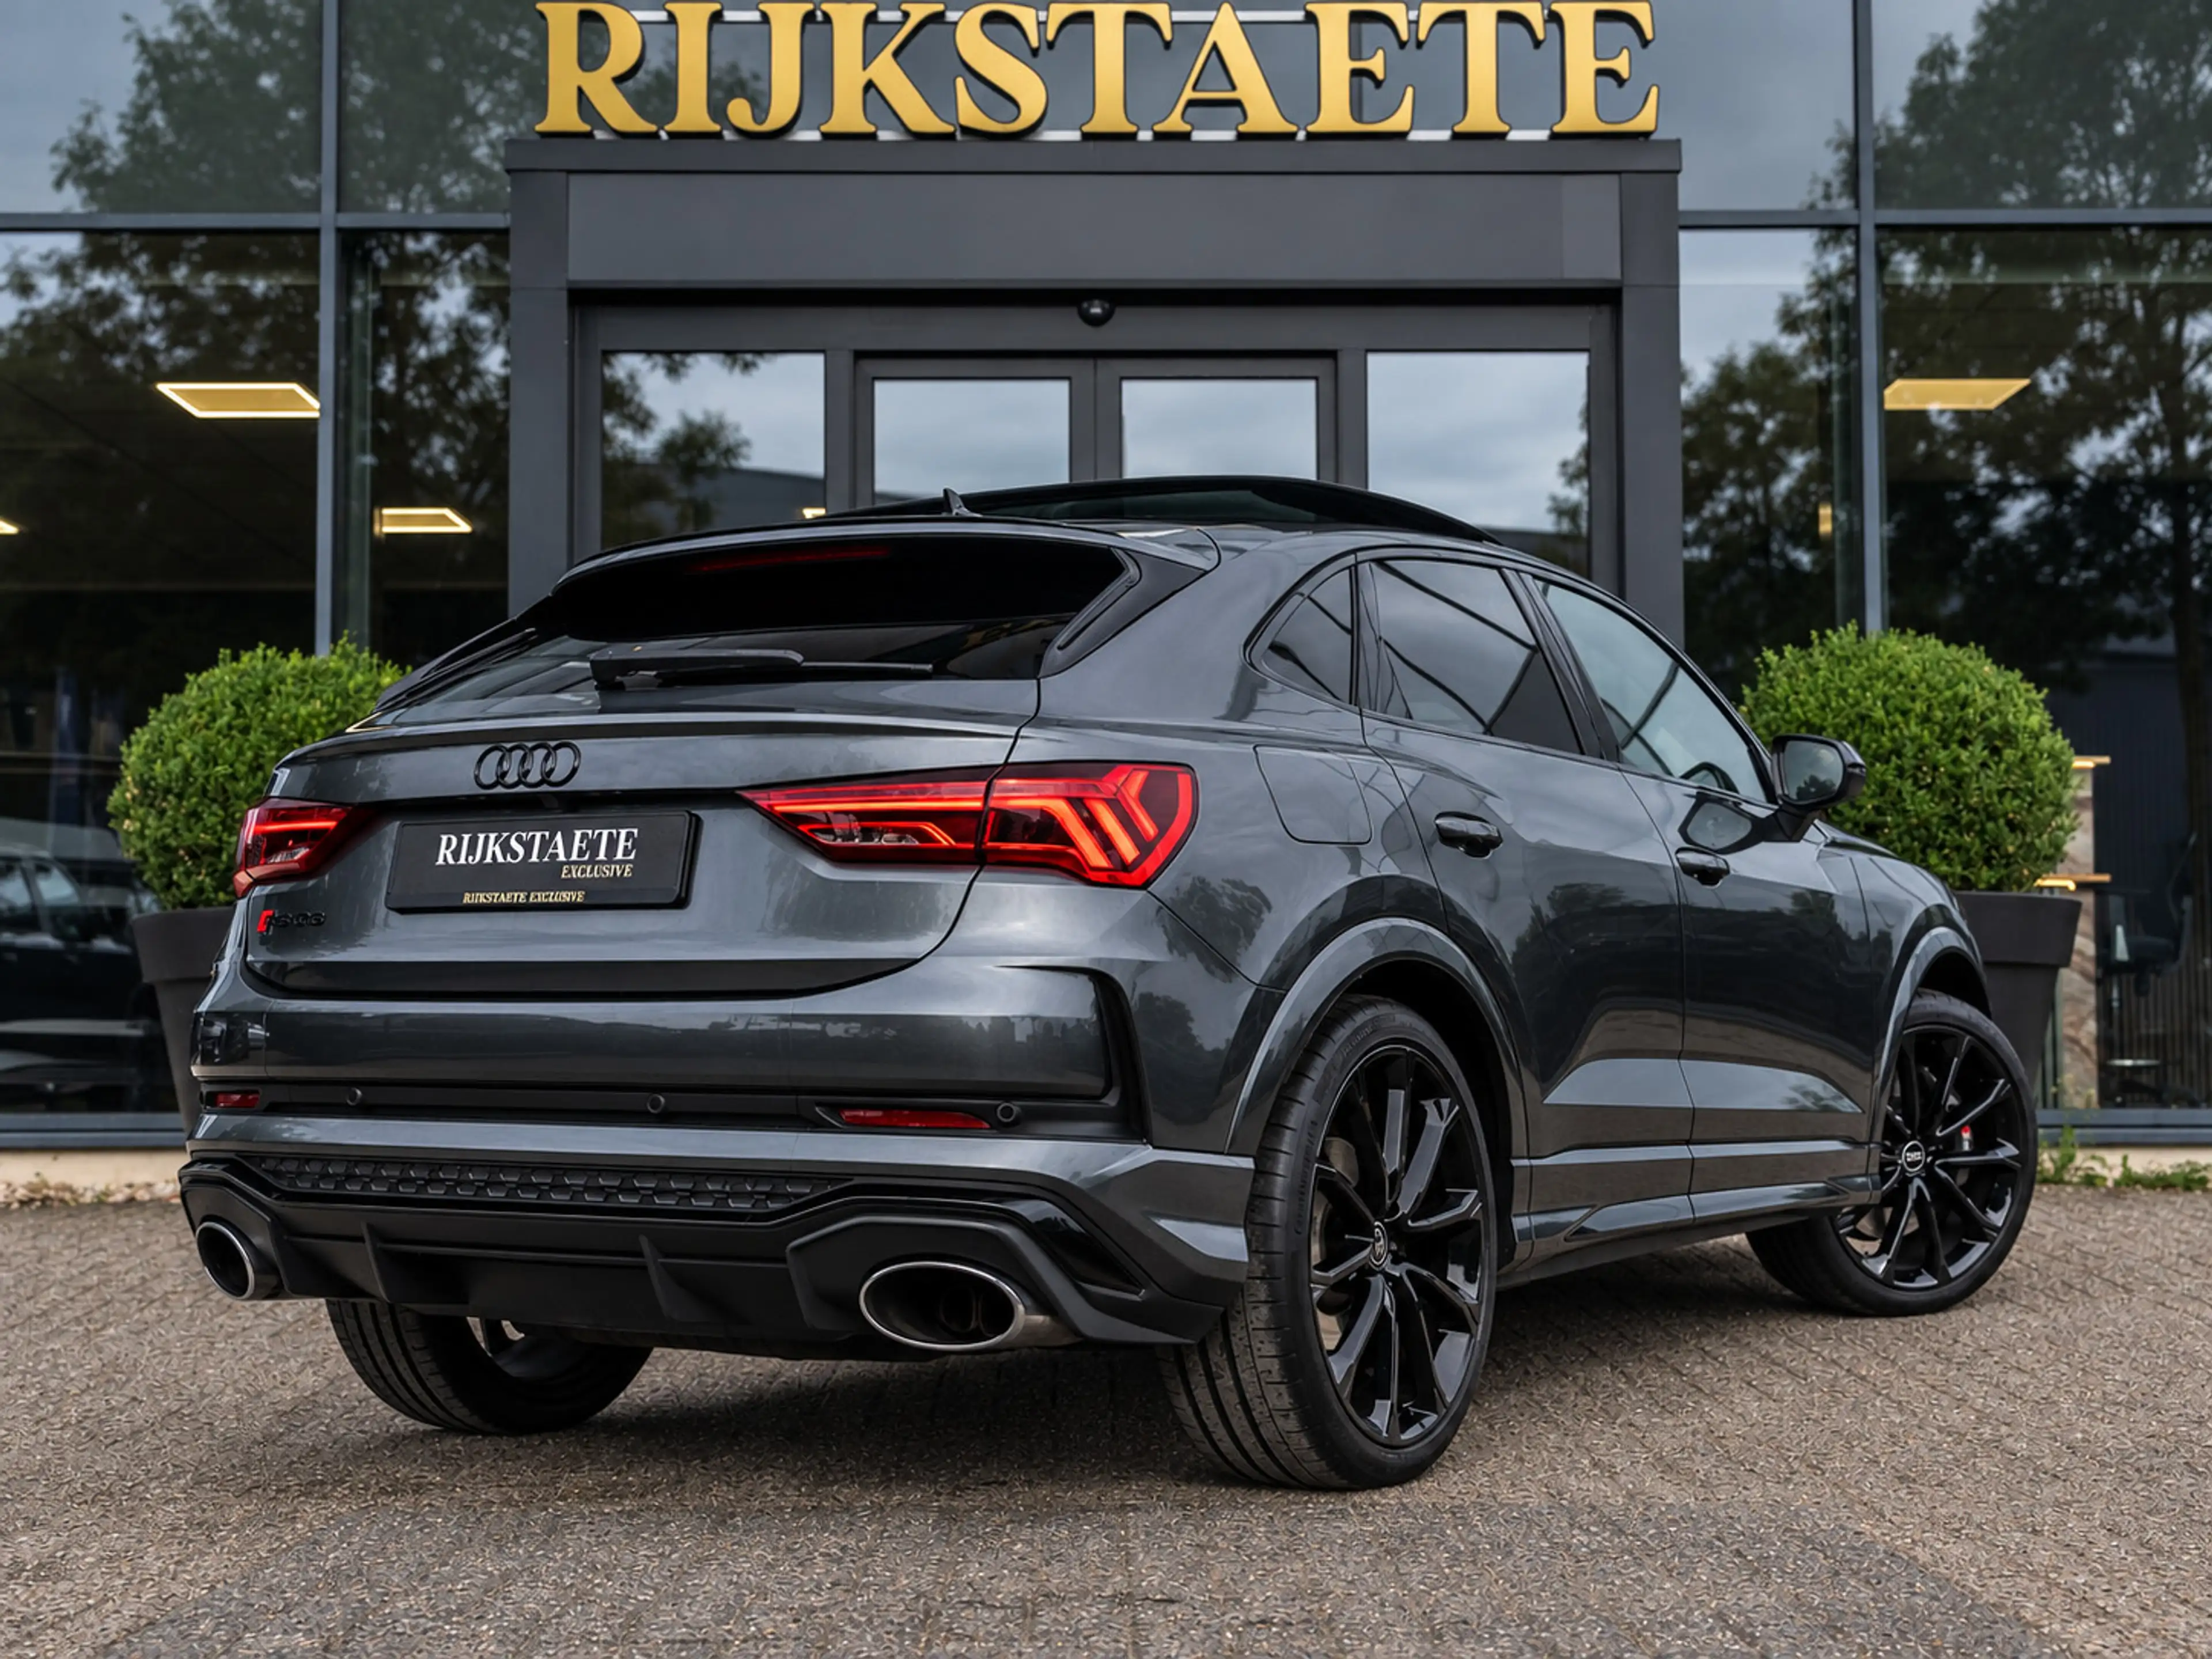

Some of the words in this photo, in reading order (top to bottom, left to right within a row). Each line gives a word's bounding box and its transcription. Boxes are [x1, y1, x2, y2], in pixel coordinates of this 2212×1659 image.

[535, 1, 1659, 136] RIJKSTAETE
[435, 828, 639, 865] RIJKSTAETE
[560, 864, 632, 878] EXCLUSIVE
[463, 892, 527, 903] RIJKSTAETE
[529, 891, 585, 902] EXCLUSIVE
